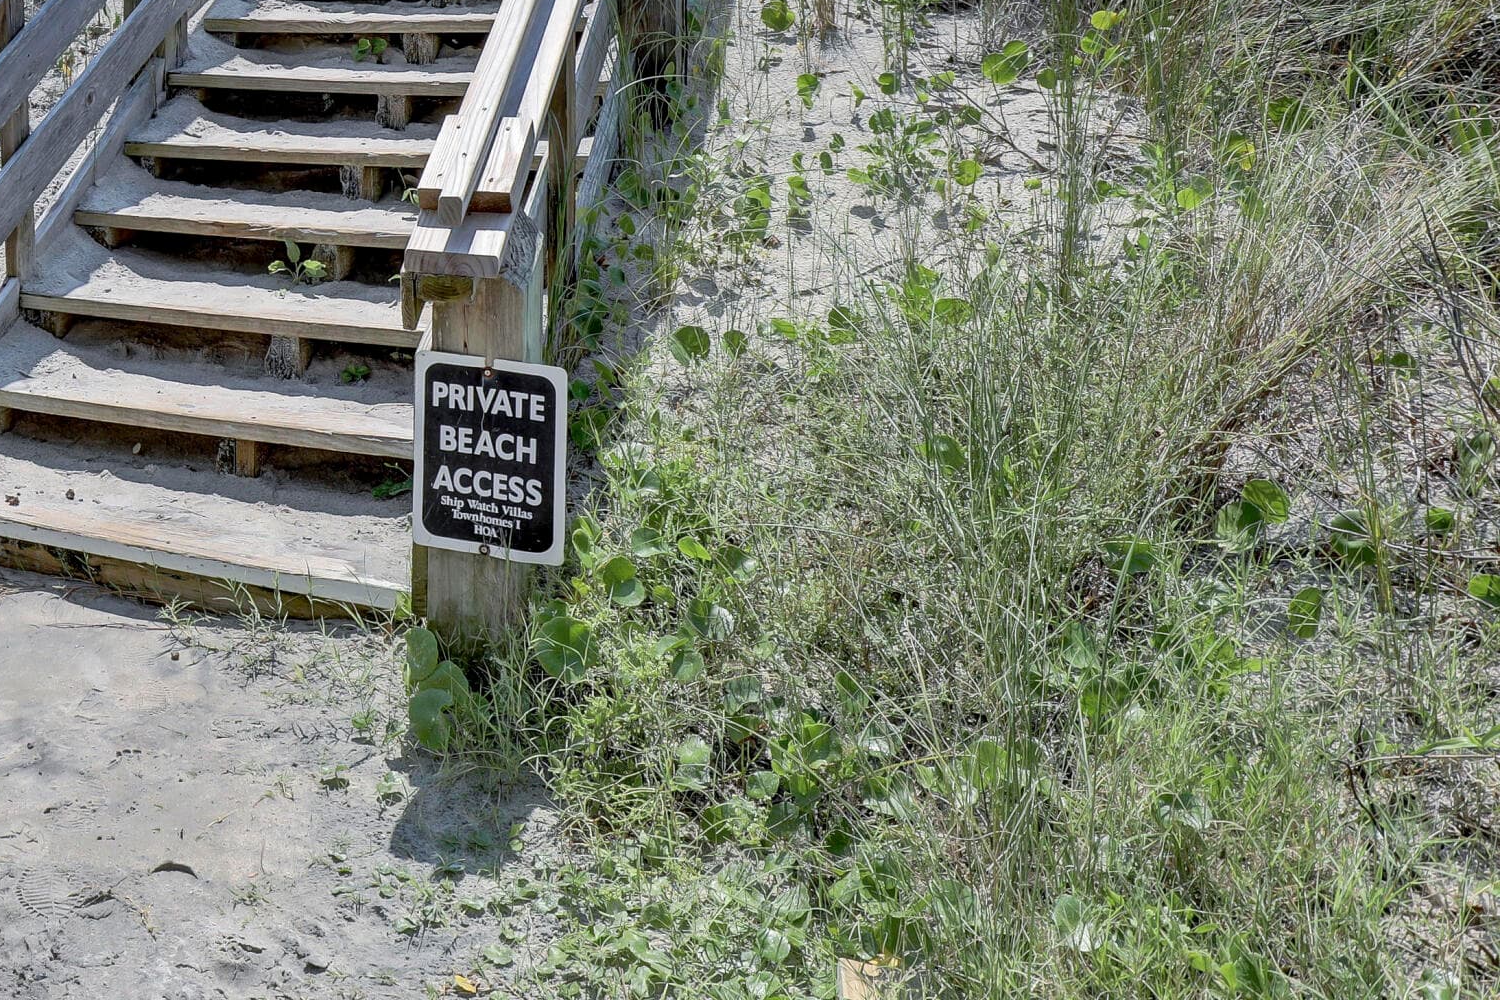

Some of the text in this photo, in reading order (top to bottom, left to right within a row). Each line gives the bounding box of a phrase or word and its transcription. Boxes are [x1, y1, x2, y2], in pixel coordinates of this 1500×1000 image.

[432, 381, 545, 422] PRIVATE
[439, 424, 537, 465] BEACH
[432, 465, 542, 507] ACCESS
[440, 495, 533, 520] Ship Watch Villas
[451, 508, 513, 529] Townhomes
[473, 524, 499, 538] HOA
